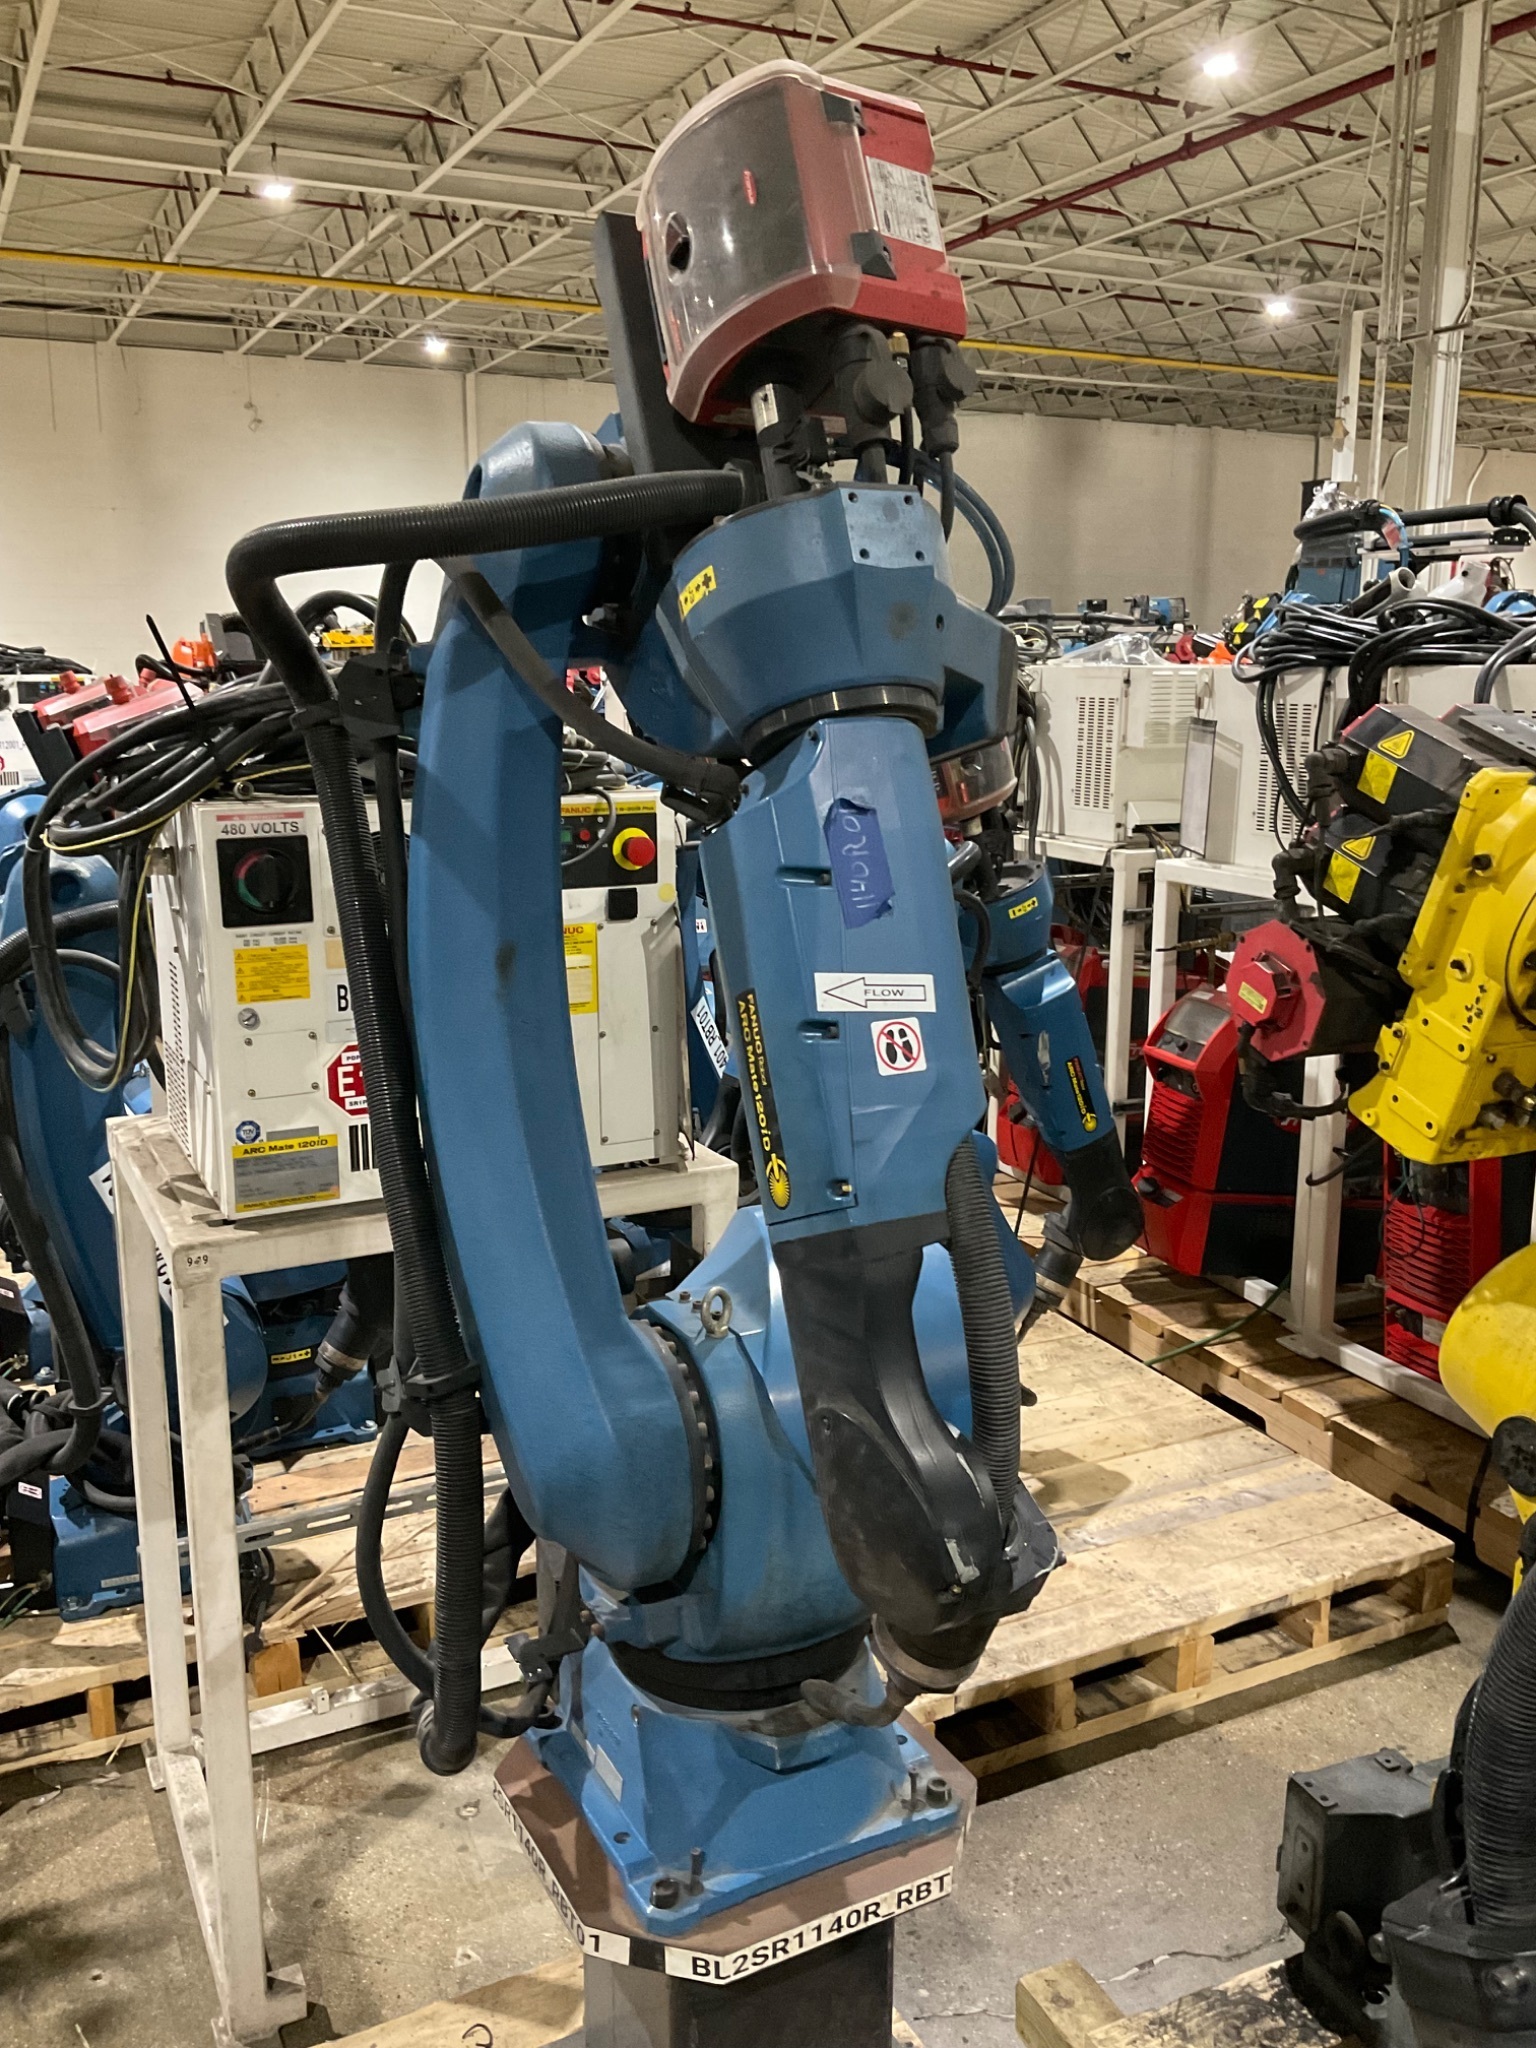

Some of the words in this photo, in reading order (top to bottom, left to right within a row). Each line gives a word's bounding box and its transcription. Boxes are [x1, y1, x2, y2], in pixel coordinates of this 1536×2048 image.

[221, 823, 246, 836] 480
[251, 821, 300, 834] VOLTS
[864, 987, 904, 997] FLOW
[738, 1000, 751, 1043] ARC
[747, 994, 763, 1054] FANUC
[242, 1146, 266, 1155] ARC
[268, 1143, 295, 1152] Mate
[691, 1872, 951, 1981] BL2SR1140R_RBT
